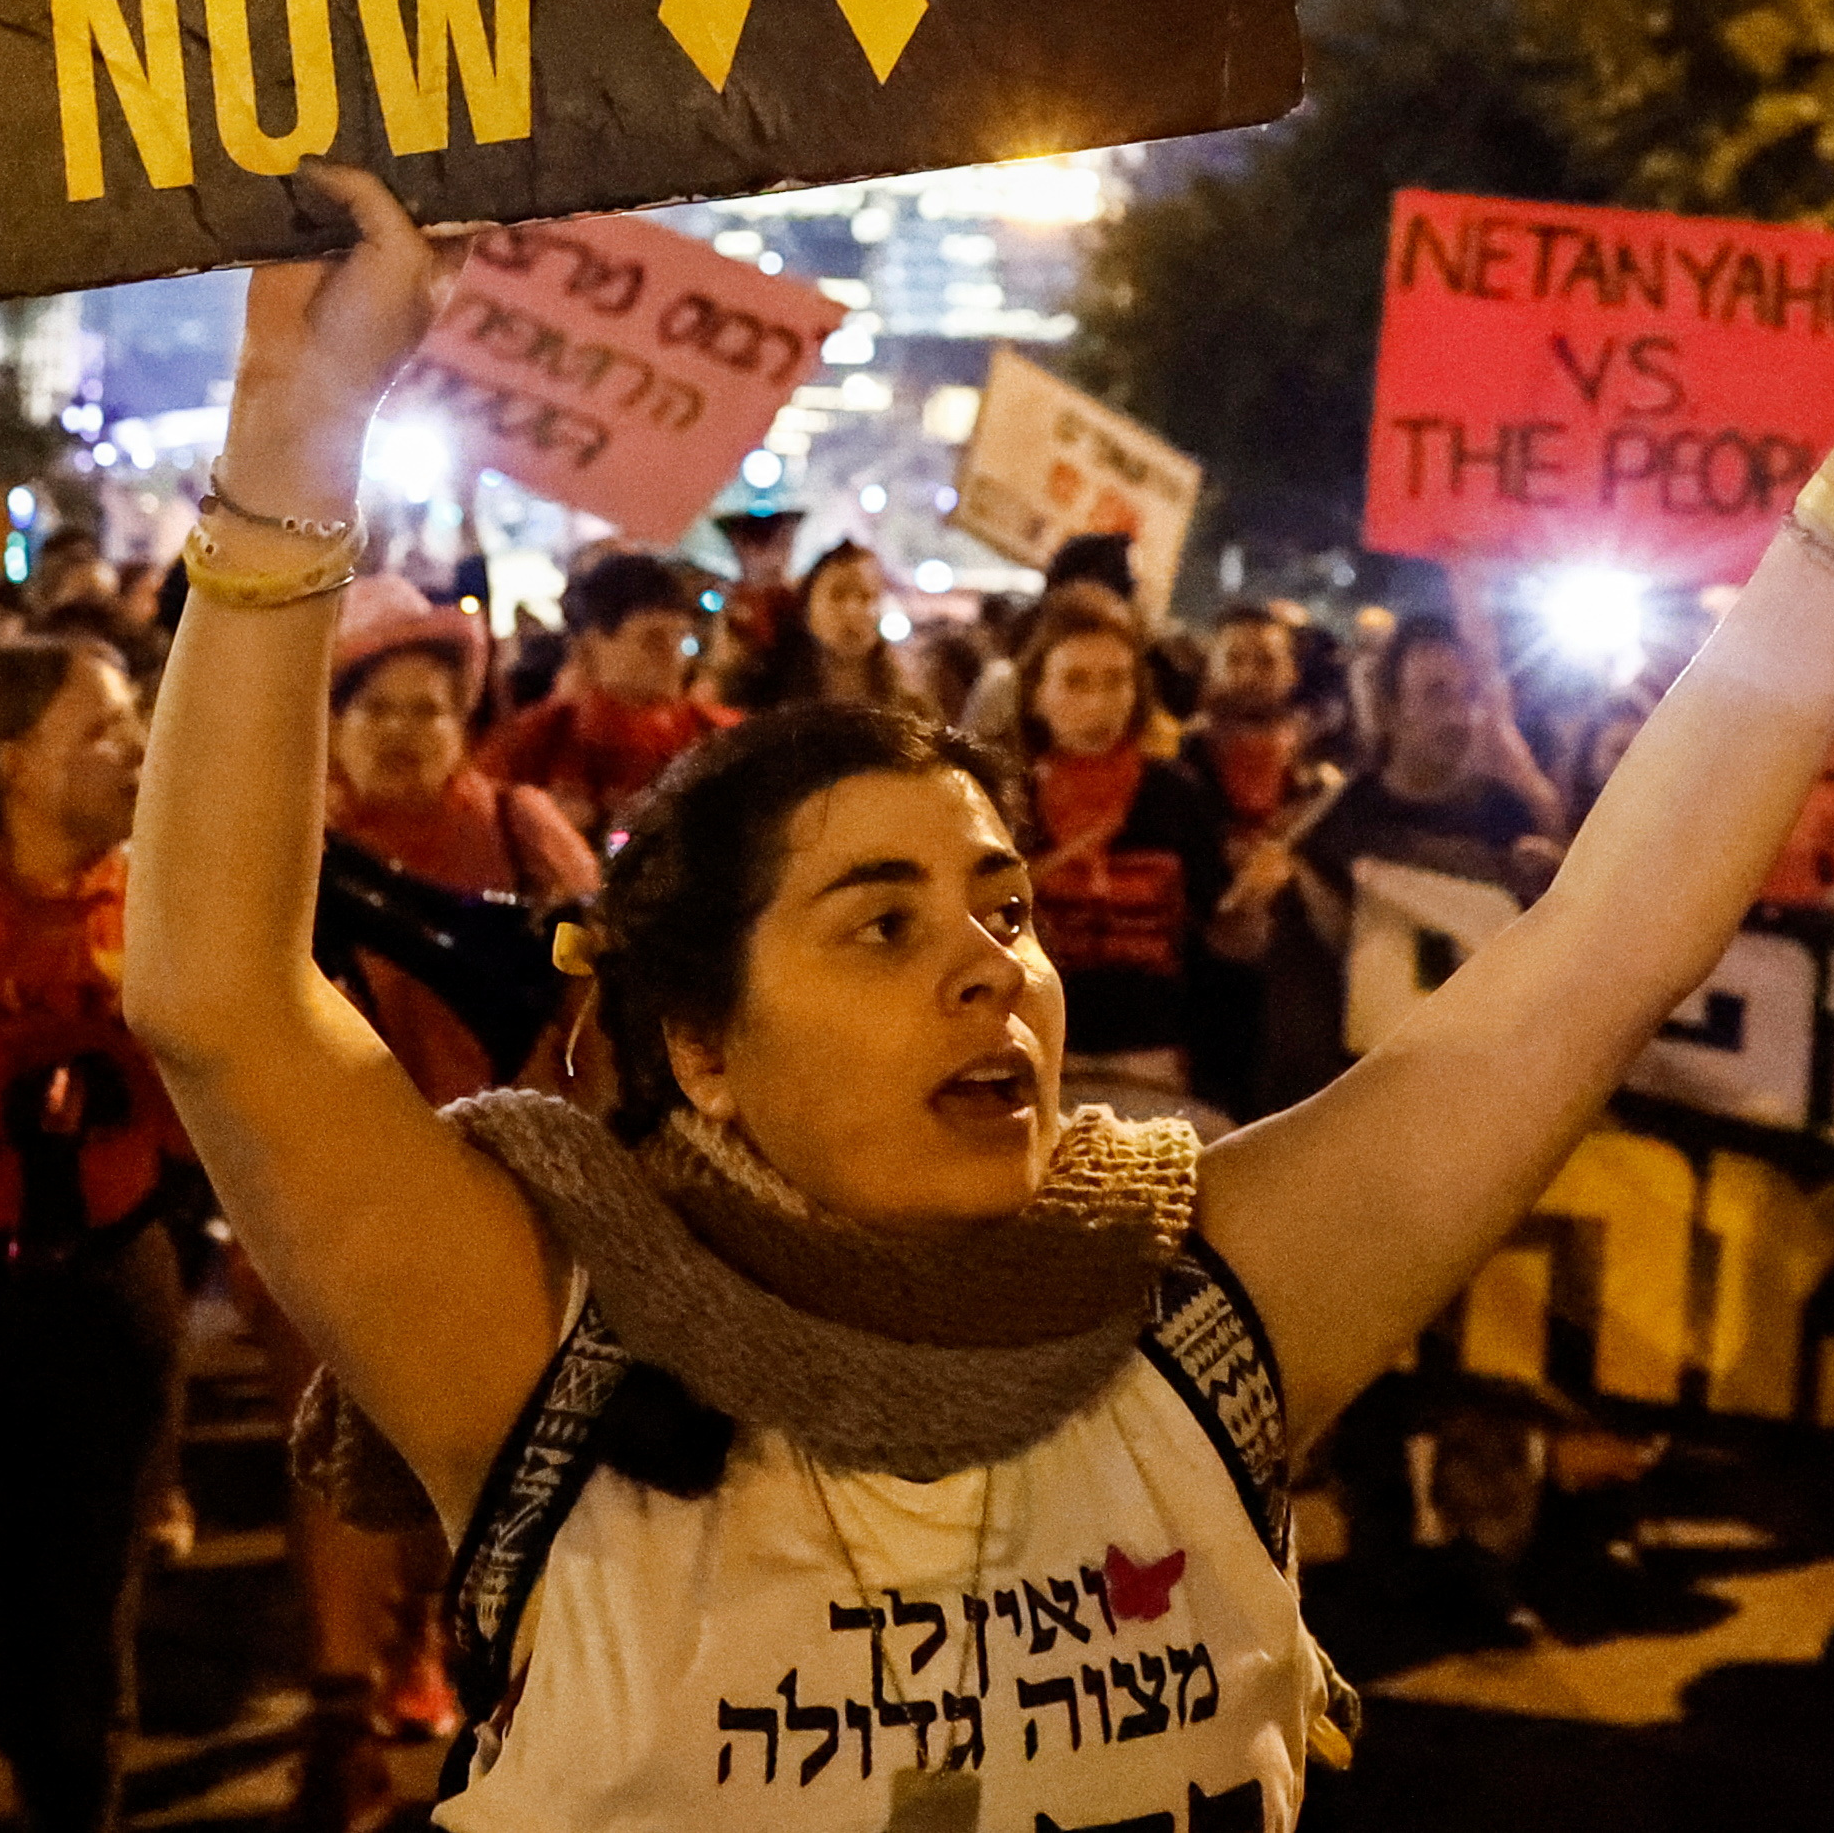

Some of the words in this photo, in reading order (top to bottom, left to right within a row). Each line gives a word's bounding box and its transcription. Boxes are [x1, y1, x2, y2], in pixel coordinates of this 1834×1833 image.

[1551, 332, 1687, 417] VS
[1393, 414, 1567, 507] THE
[1601, 425, 1818, 514] PEOP
[830, 1587, 947, 1708] לך
[965, 1566, 1117, 1698] ואין
[717, 1667, 985, 1786] גדולה
[1016, 1642, 1221, 1762] מצוה
